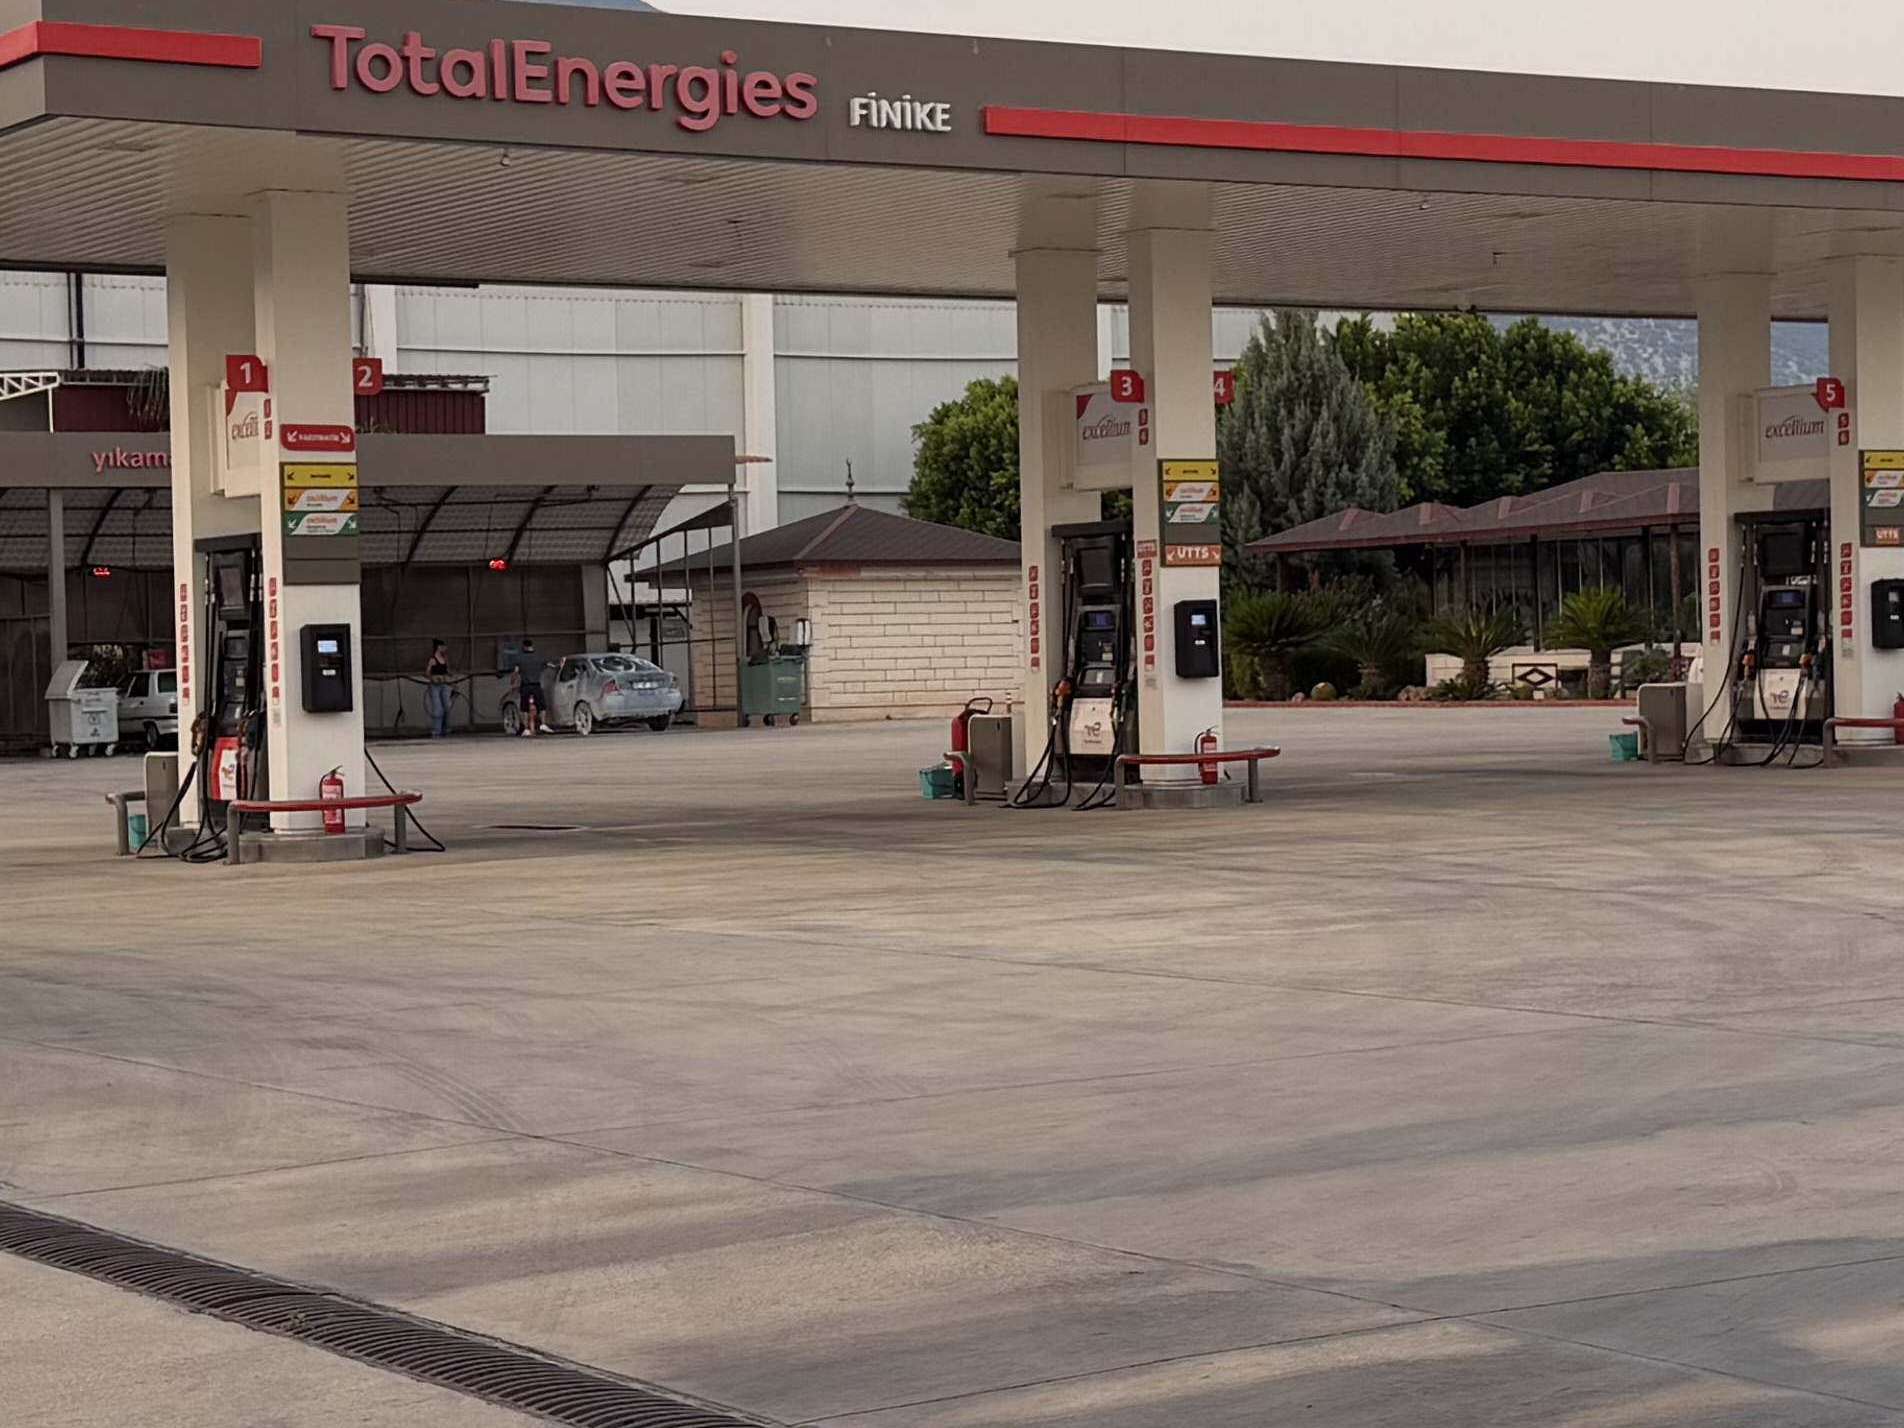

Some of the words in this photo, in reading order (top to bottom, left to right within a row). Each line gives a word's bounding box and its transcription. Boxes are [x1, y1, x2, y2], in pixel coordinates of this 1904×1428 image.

[312, 23, 818, 131] TotalEnergies
[850, 91, 952, 132] FİNİKE
[239, 362, 251, 384] 1
[358, 365, 374, 388] 2
[1120, 376, 1132, 397] 3
[1213, 377, 1226, 397] 4
[1826, 384, 1836, 402] 5
[1765, 417, 1824, 439] excellium
[92, 447, 172, 475] yıkam
[1176, 547, 1209, 559] UTTS
